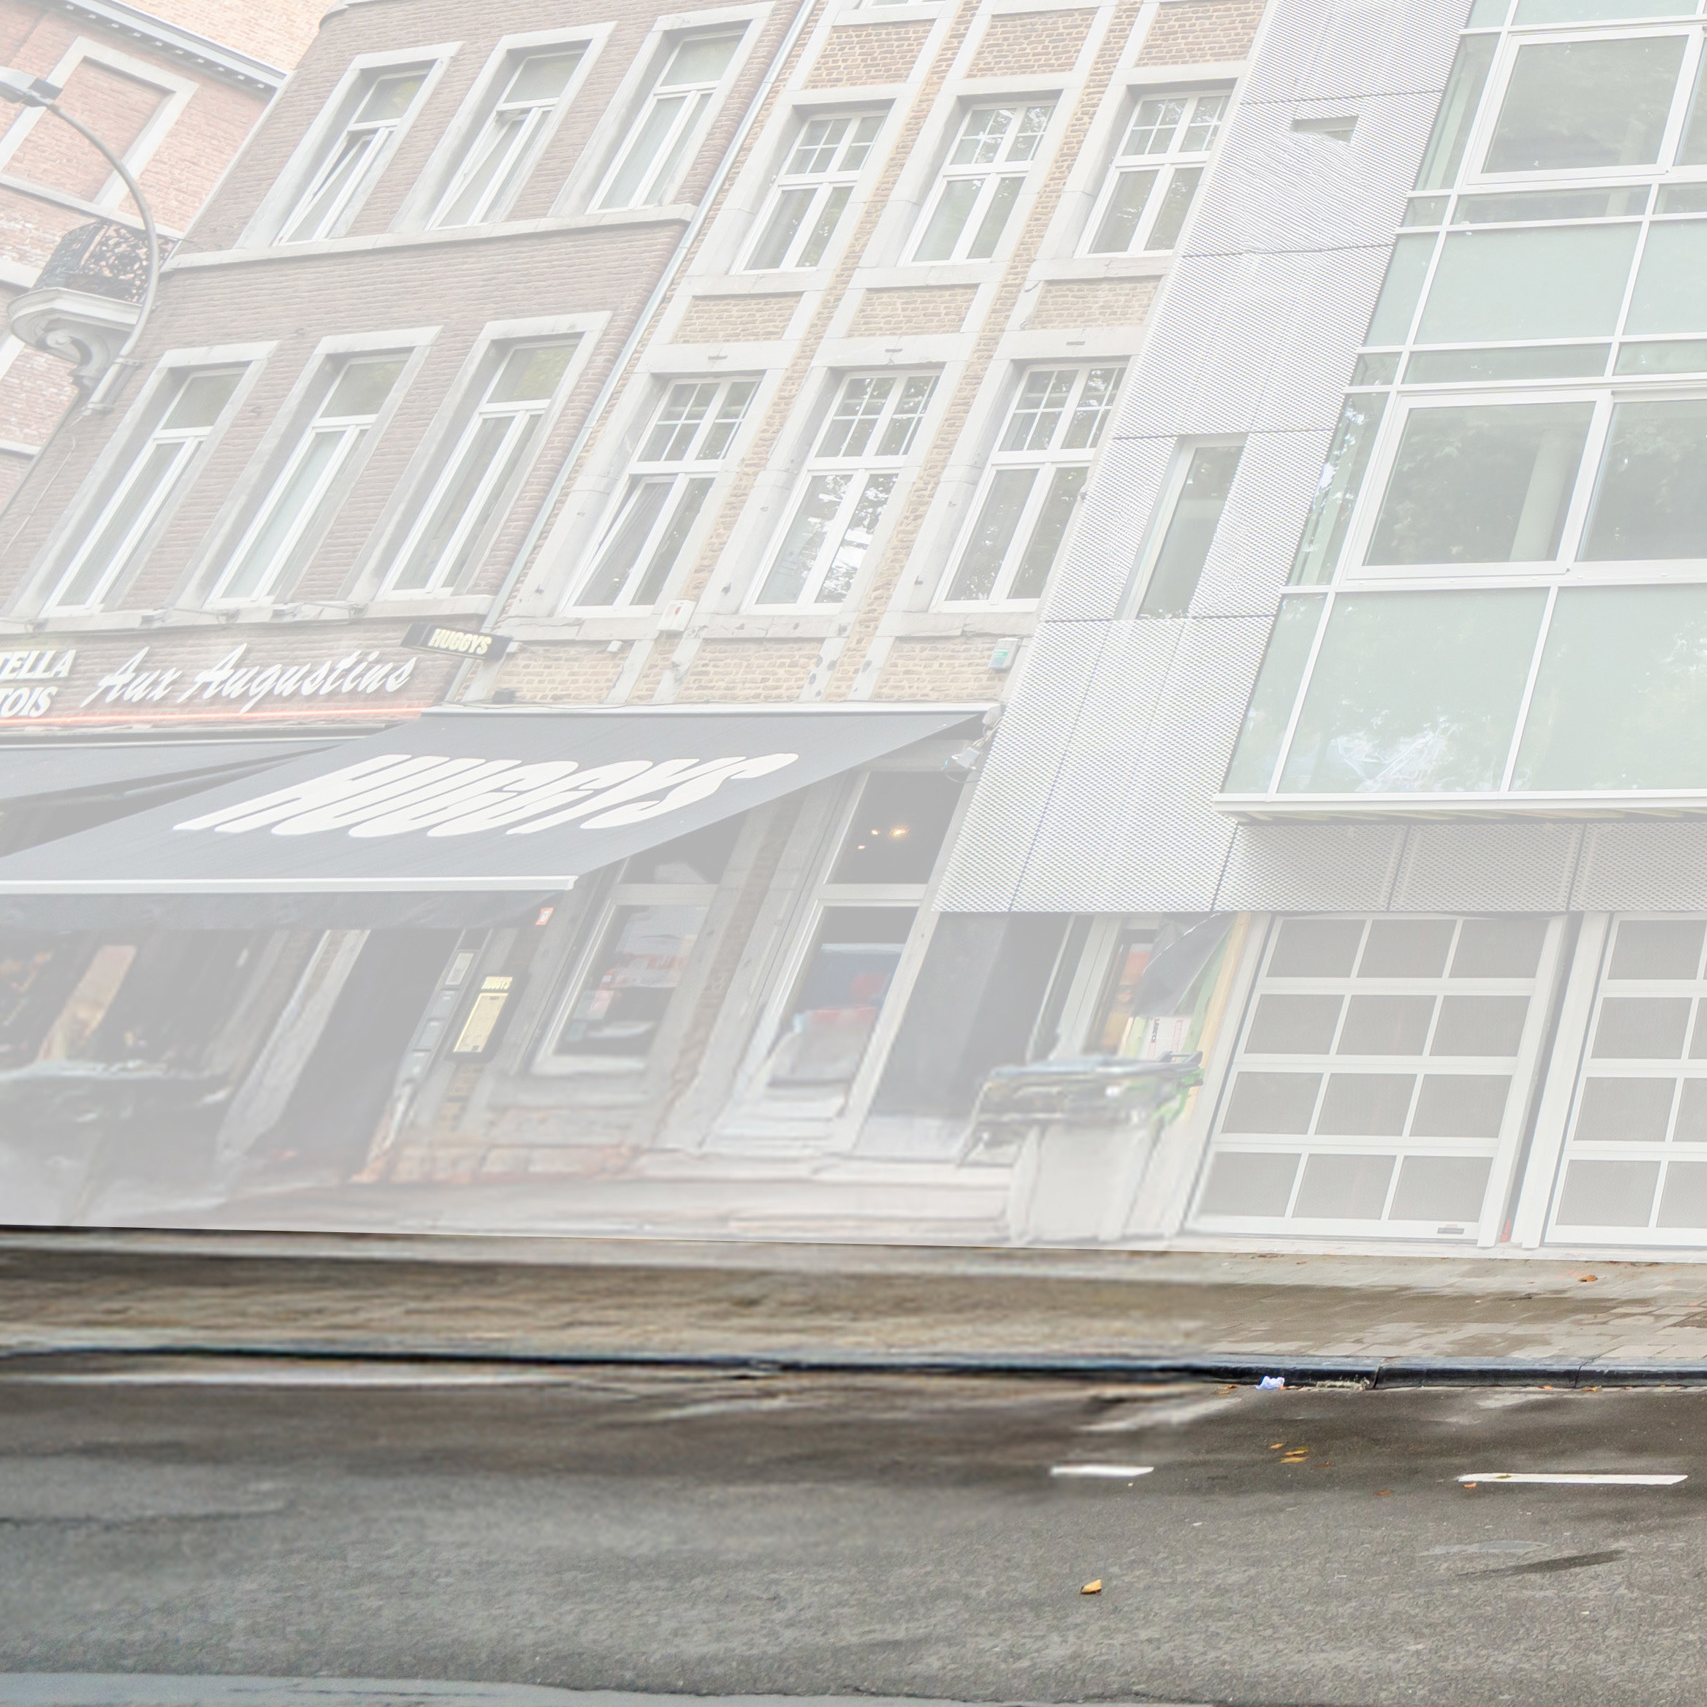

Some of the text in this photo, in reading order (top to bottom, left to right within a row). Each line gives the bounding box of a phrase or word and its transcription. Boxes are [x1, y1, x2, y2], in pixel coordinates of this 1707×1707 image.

[427, 628, 492, 655] HUGGYS
[80, 643, 418, 714] Aux Augustins
[172, 753, 800, 839] HUGGYS
